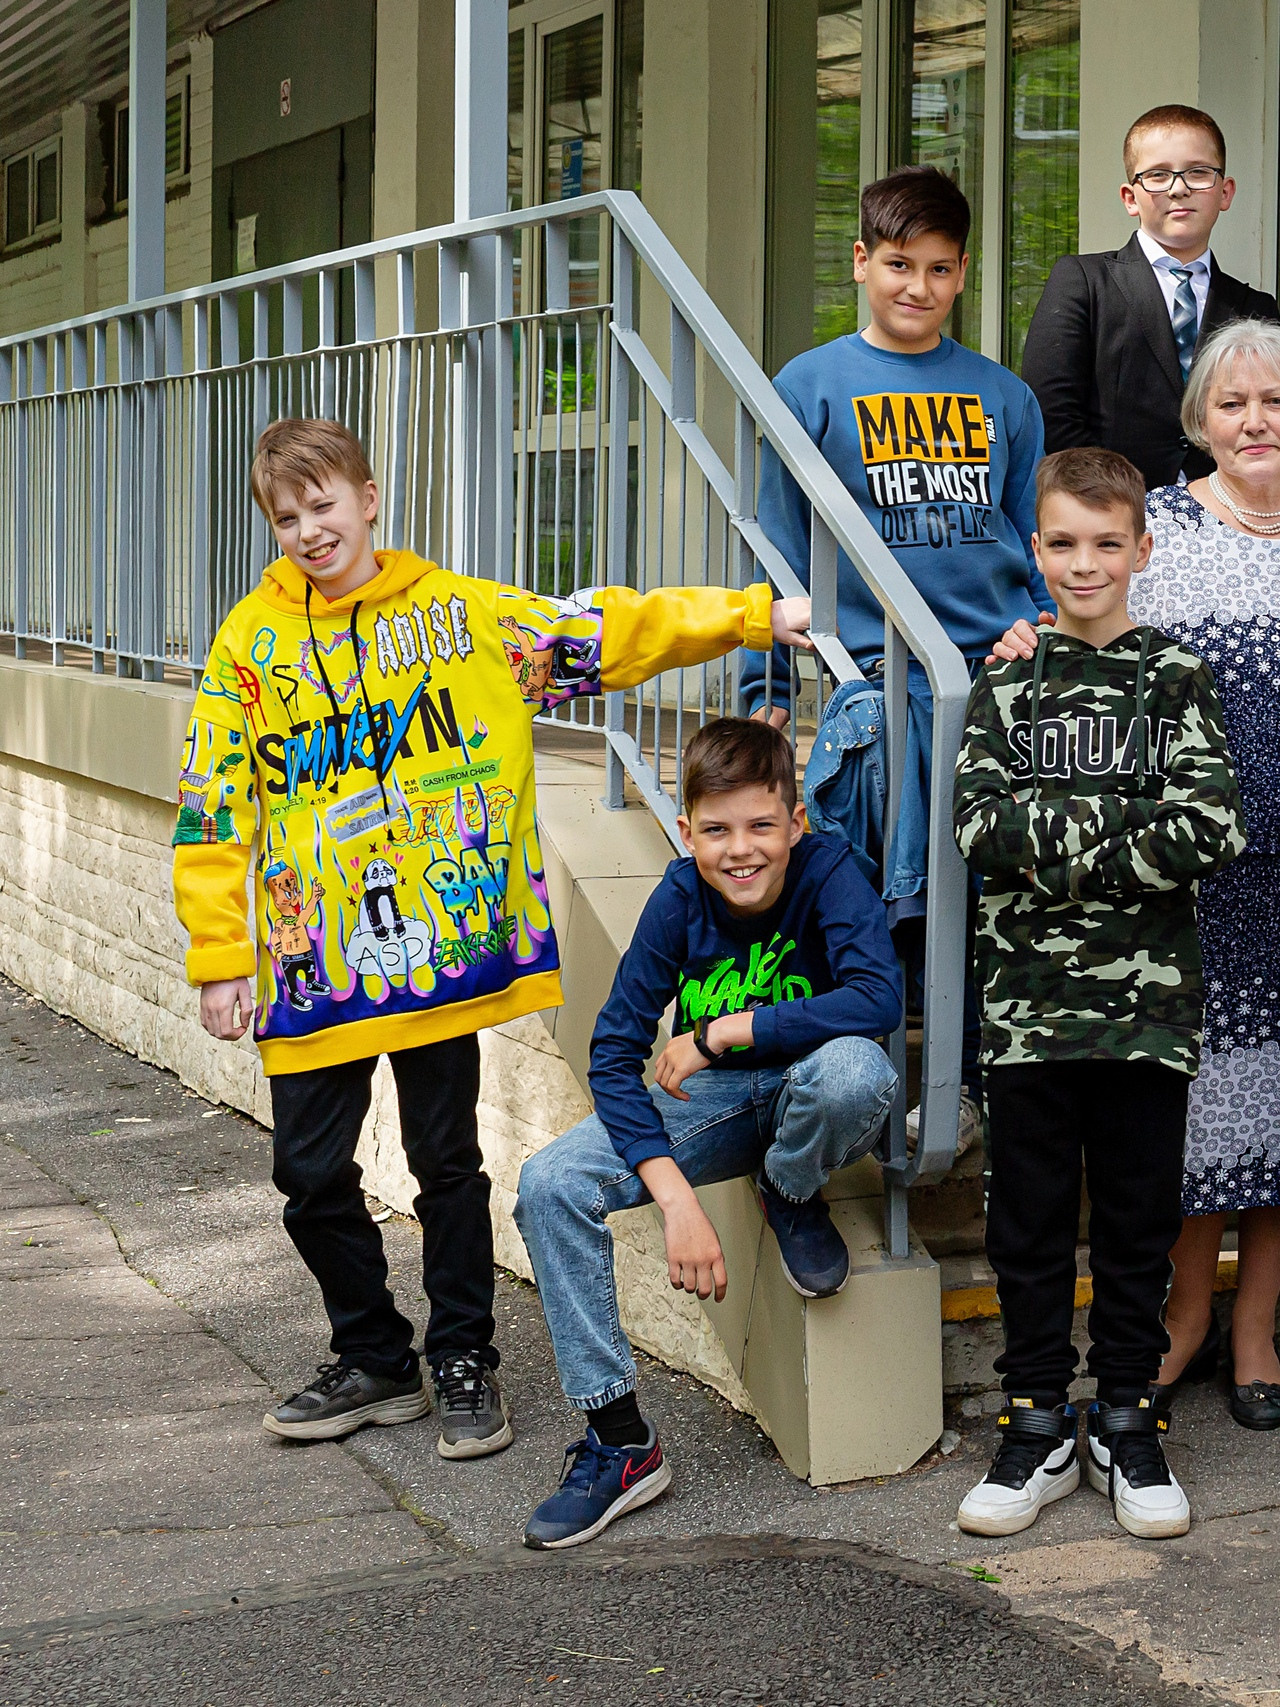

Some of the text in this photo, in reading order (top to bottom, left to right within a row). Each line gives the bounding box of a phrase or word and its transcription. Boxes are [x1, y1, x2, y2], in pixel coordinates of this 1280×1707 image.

[856, 396, 987, 459] MAKE
[866, 461, 990, 506] THE MOST
[881, 507, 919, 543] OUT
[925, 504, 957, 549] OF
[423, 776, 445, 787] CASH
[446, 771, 468, 782] FROM
[470, 764, 496, 776] CHAOS
[310, 797, 327, 806] 4:19
[998, 1416, 1010, 1425] FILA
[1157, 1420, 1167, 1430] FILA
